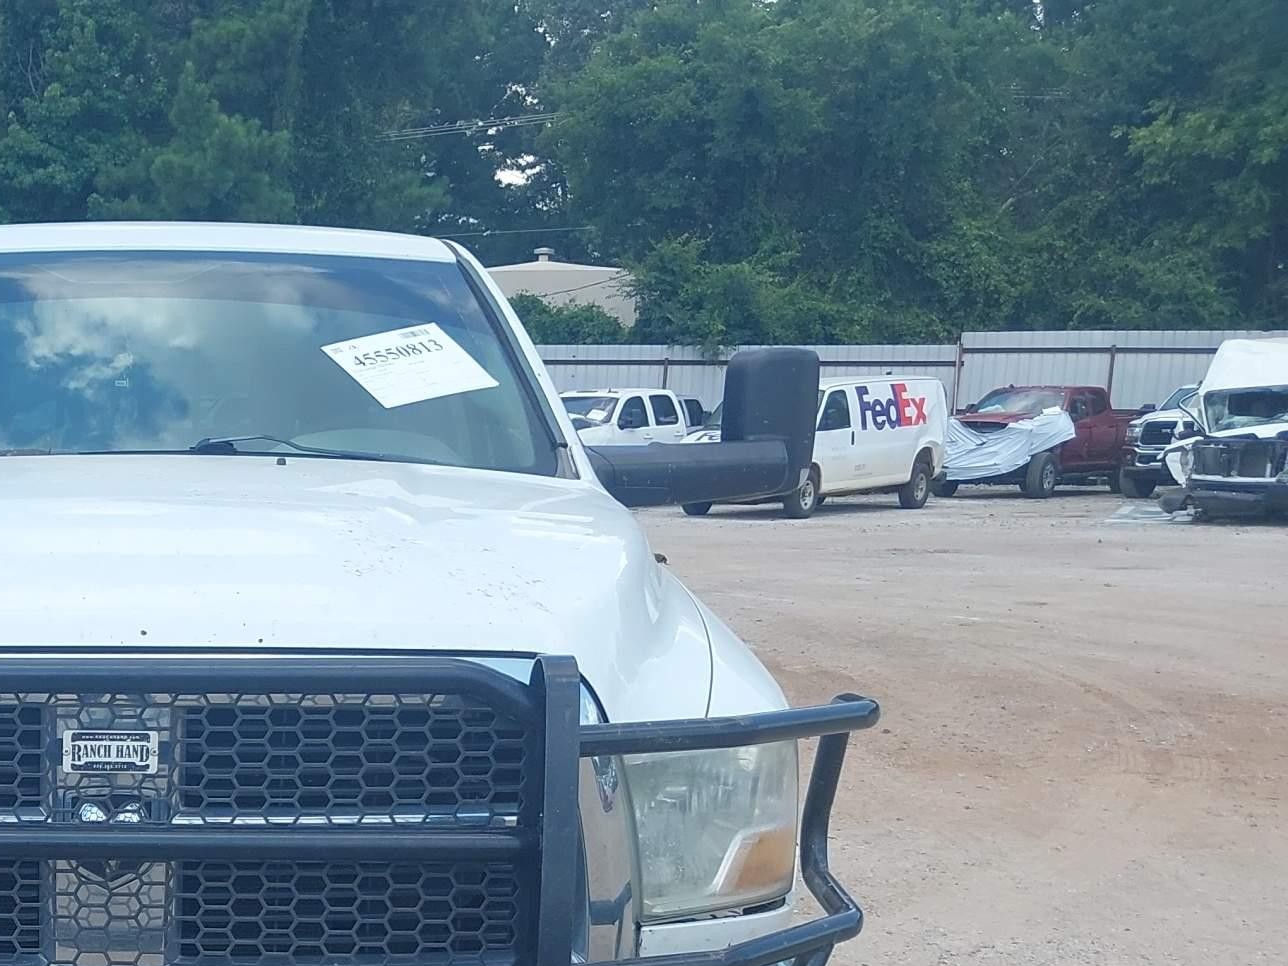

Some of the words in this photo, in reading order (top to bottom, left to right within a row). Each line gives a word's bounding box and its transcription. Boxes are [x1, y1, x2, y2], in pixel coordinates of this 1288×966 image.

[353, 339, 444, 367] 45550813
[854, 383, 927, 430] FedEx
[71, 743, 112, 762] RANCH
[115, 743, 150, 763] HAND
